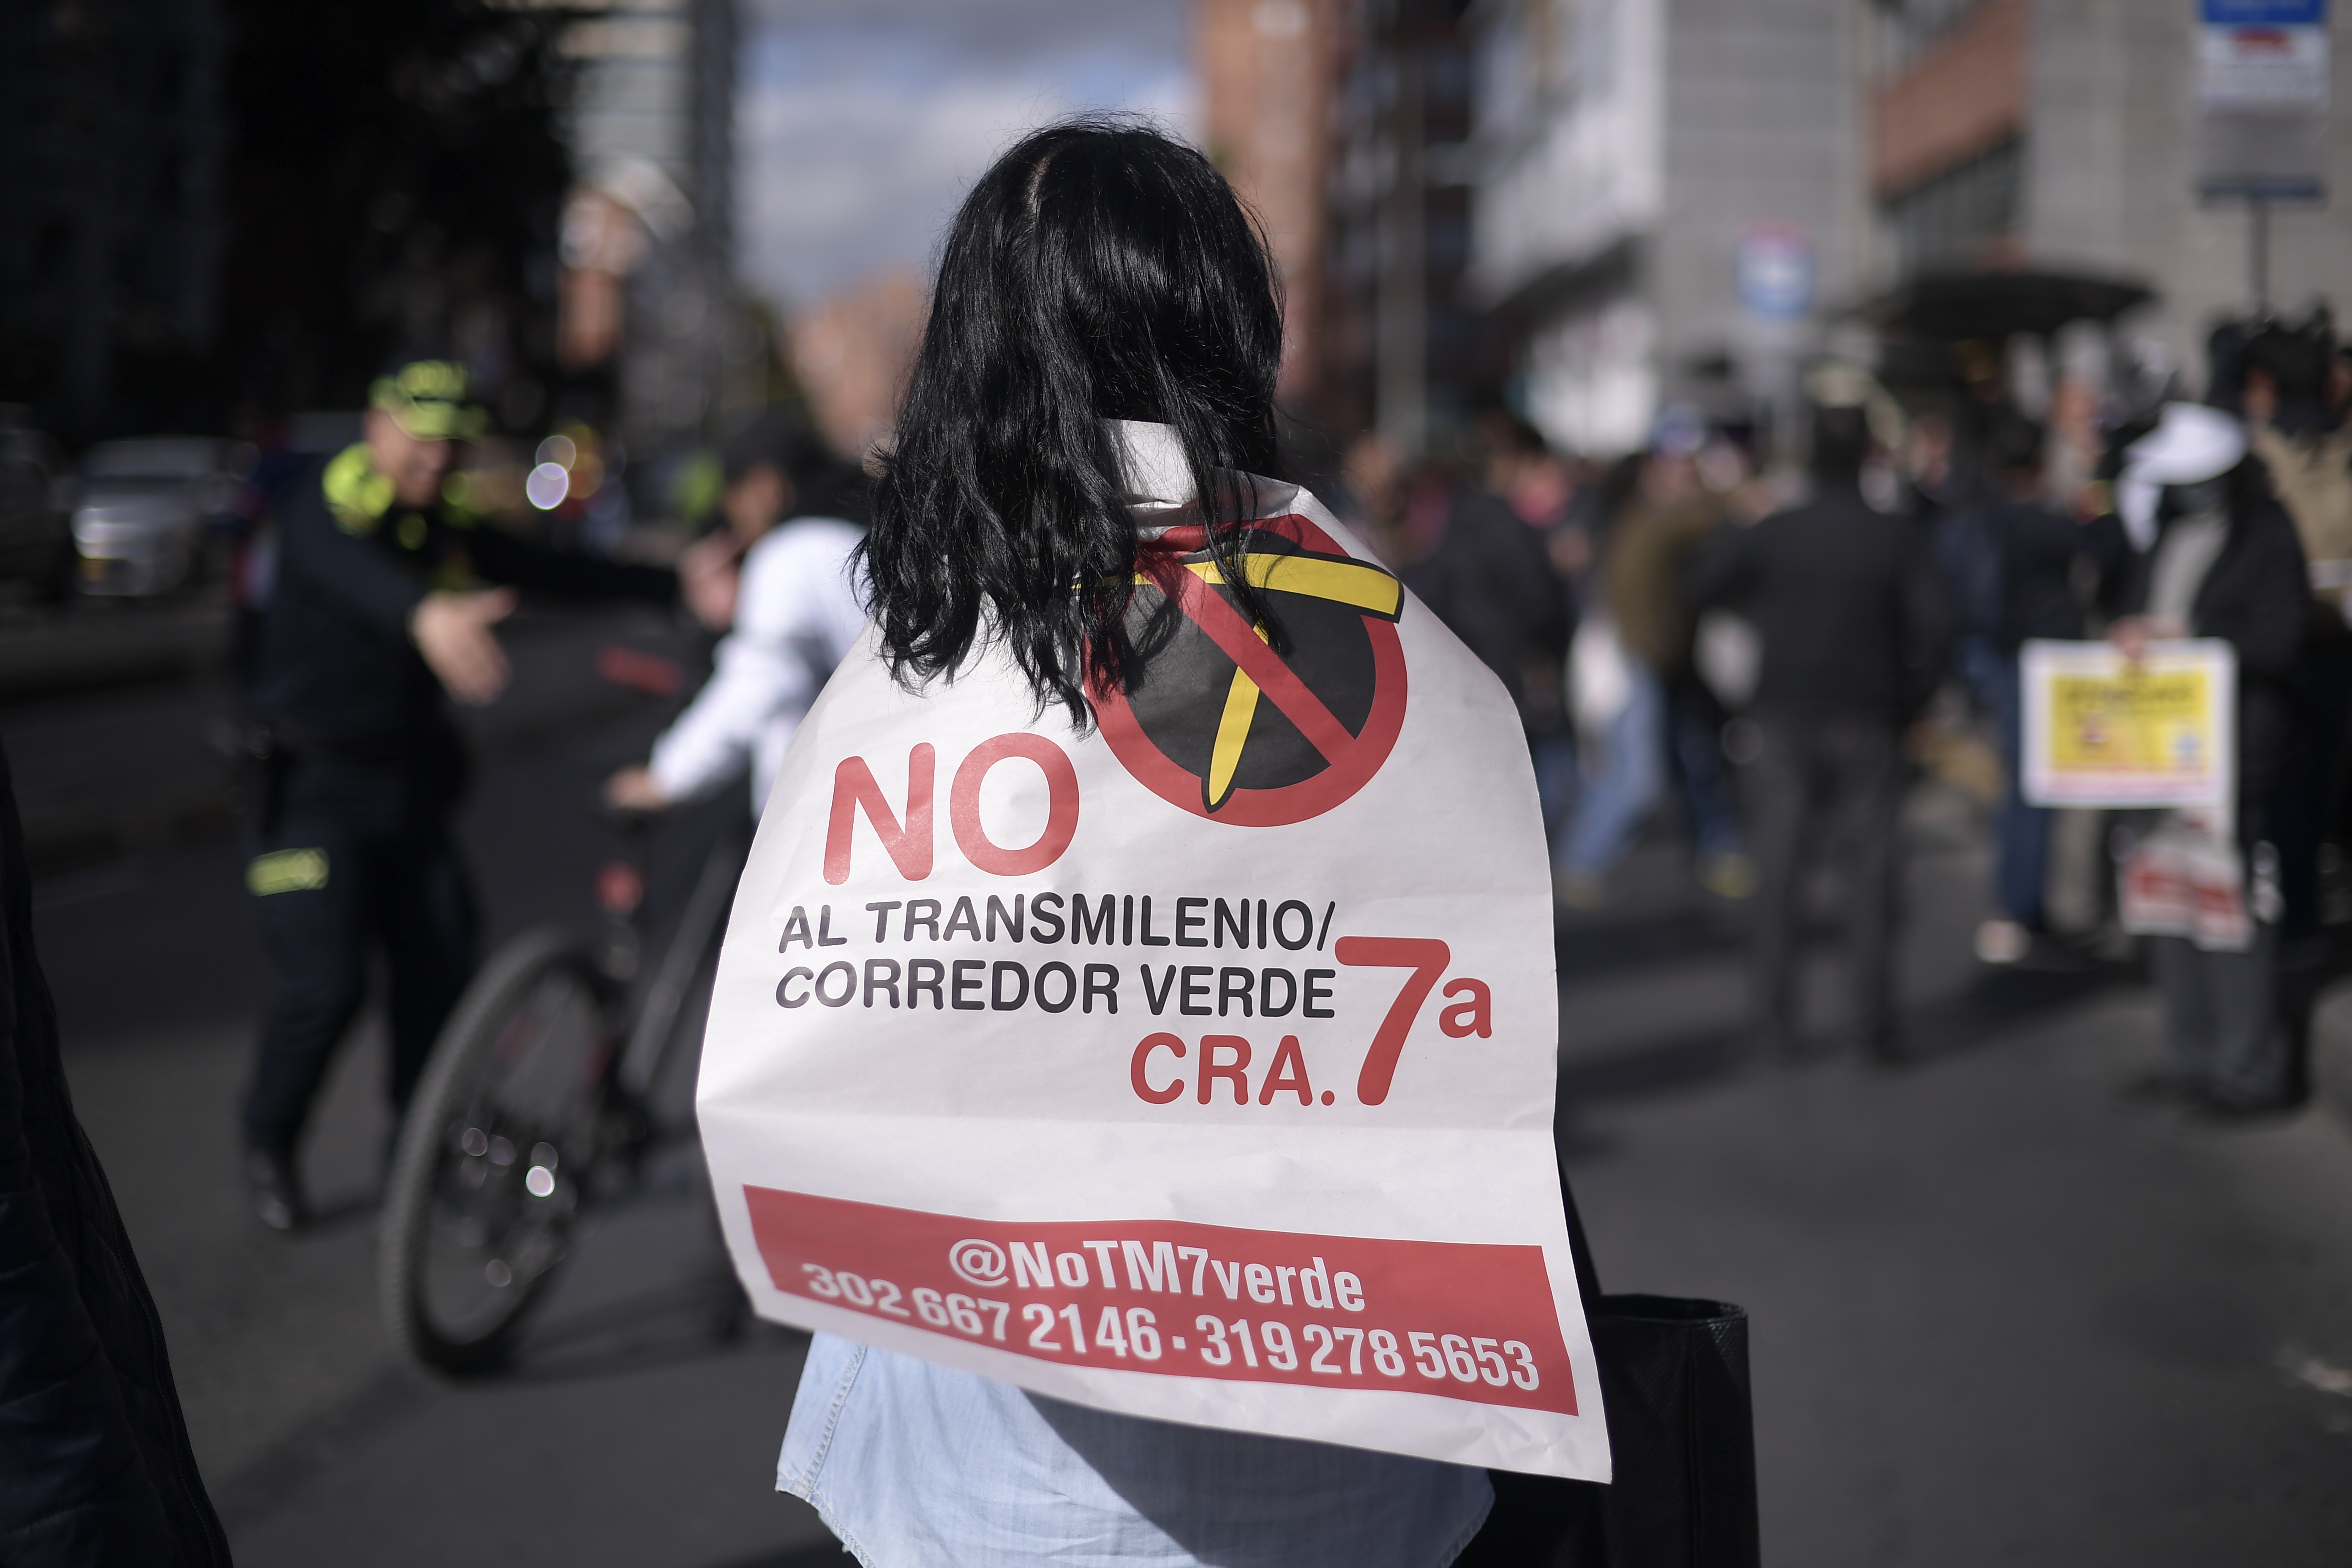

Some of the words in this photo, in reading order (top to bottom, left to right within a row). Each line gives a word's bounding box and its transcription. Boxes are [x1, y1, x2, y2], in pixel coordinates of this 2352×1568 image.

[823, 732, 1080, 886] NO
[778, 902, 848, 954] AL
[865, 891, 1337, 952] TRANSMILENIO/
[775, 958, 1119, 1015] CORREDOR
[1140, 963, 1337, 1019] VERDE
[1130, 1032, 1336, 1107] CRA.
[949, 1238, 1365, 1312] @NoTM7verde
[801, 1263, 910, 1317] 302
[911, 1287, 1010, 1341] 667
[1022, 1302, 1162, 1361] 2146
[1195, 1314, 1299, 1371] 319
[1302, 1323, 1406, 1377] 278
[1407, 1331, 1540, 1391] 5653
